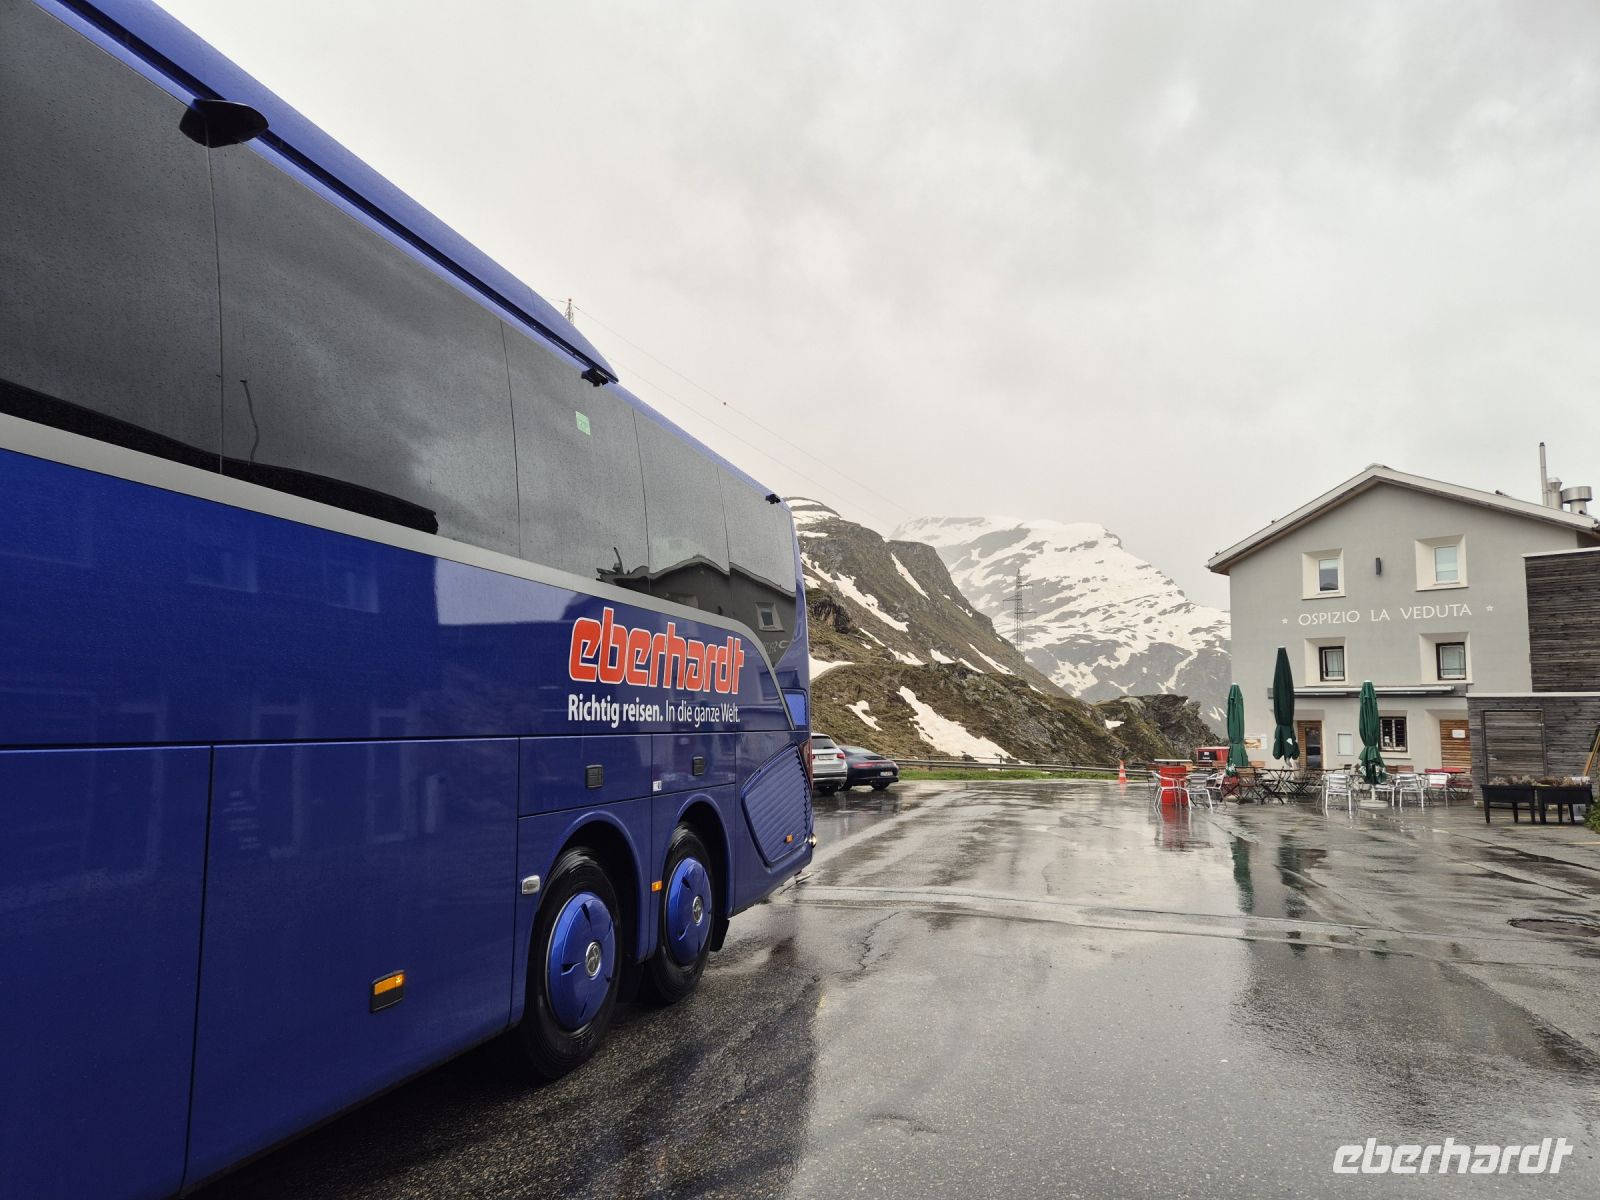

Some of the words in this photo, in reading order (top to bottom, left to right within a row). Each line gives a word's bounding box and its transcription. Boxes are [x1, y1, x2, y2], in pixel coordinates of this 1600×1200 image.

[1298, 610, 1361, 626] OSPIZIO
[1370, 608, 1391, 622] LA
[1400, 603, 1473, 620] VEDUTA
[568, 606, 745, 695] eberhardt
[567, 693, 620, 728] Richtig
[622, 697, 664, 722] reisen.
[665, 700, 675, 722] In
[677, 700, 692, 722] die
[694, 706, 720, 728] ganze
[720, 702, 741, 723] Welt.
